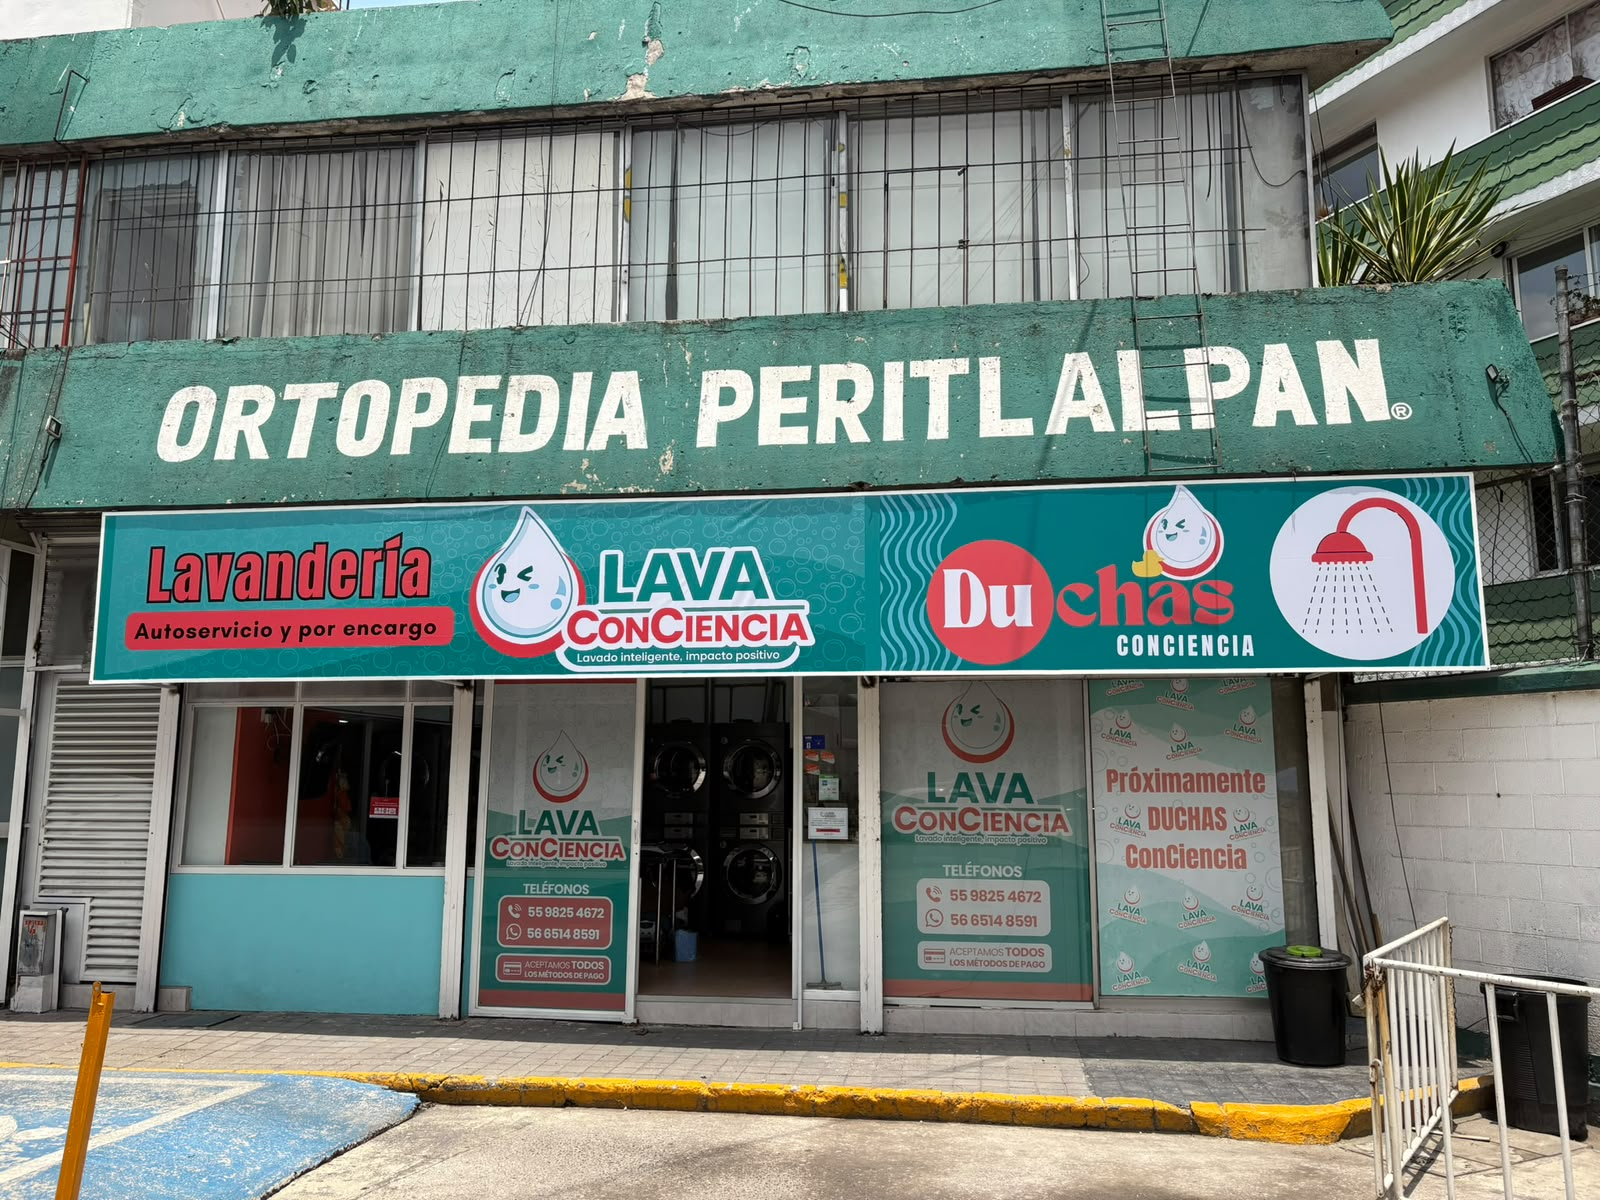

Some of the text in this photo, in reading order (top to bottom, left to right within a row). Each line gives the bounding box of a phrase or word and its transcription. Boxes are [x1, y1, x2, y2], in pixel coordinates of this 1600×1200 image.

[156, 371, 648, 463] ORTOPEDIA
[146, 531, 433, 603] Lavandería
[603, 550, 769, 603] LAVA
[134, 620, 437, 643] Autoservicio y por encargo
[1116, 633, 1255, 657] CONCIENCIA
[576, 649, 781, 664] Lavado inteligente, impacto positivo
[927, 771, 1034, 804] LAVA
[1106, 766, 1266, 794] Próximamente
[518, 810, 599, 835] LAVA
[1147, 806, 1228, 831] DUCHAS
[1125, 843, 1248, 870] ConCiencia
[942, 861, 1022, 878] TELÉFONOS
[523, 881, 590, 895] TELÉFONOS
[950, 889, 1041, 903] 55 9825 4672
[528, 906, 605, 919] 55 9825 4672
[951, 914, 1037, 928] 56 6514 8591
[527, 928, 600, 940] 56 6514 8591
[950, 947, 1045, 957] ACEPTAMOS TODOS
[525, 960, 604, 970] ACEPTAMOS TODOS
[950, 957, 1046, 969] LOS MÉTODOS DE PAGO
[538, 970, 573, 979] MÉTODOS
